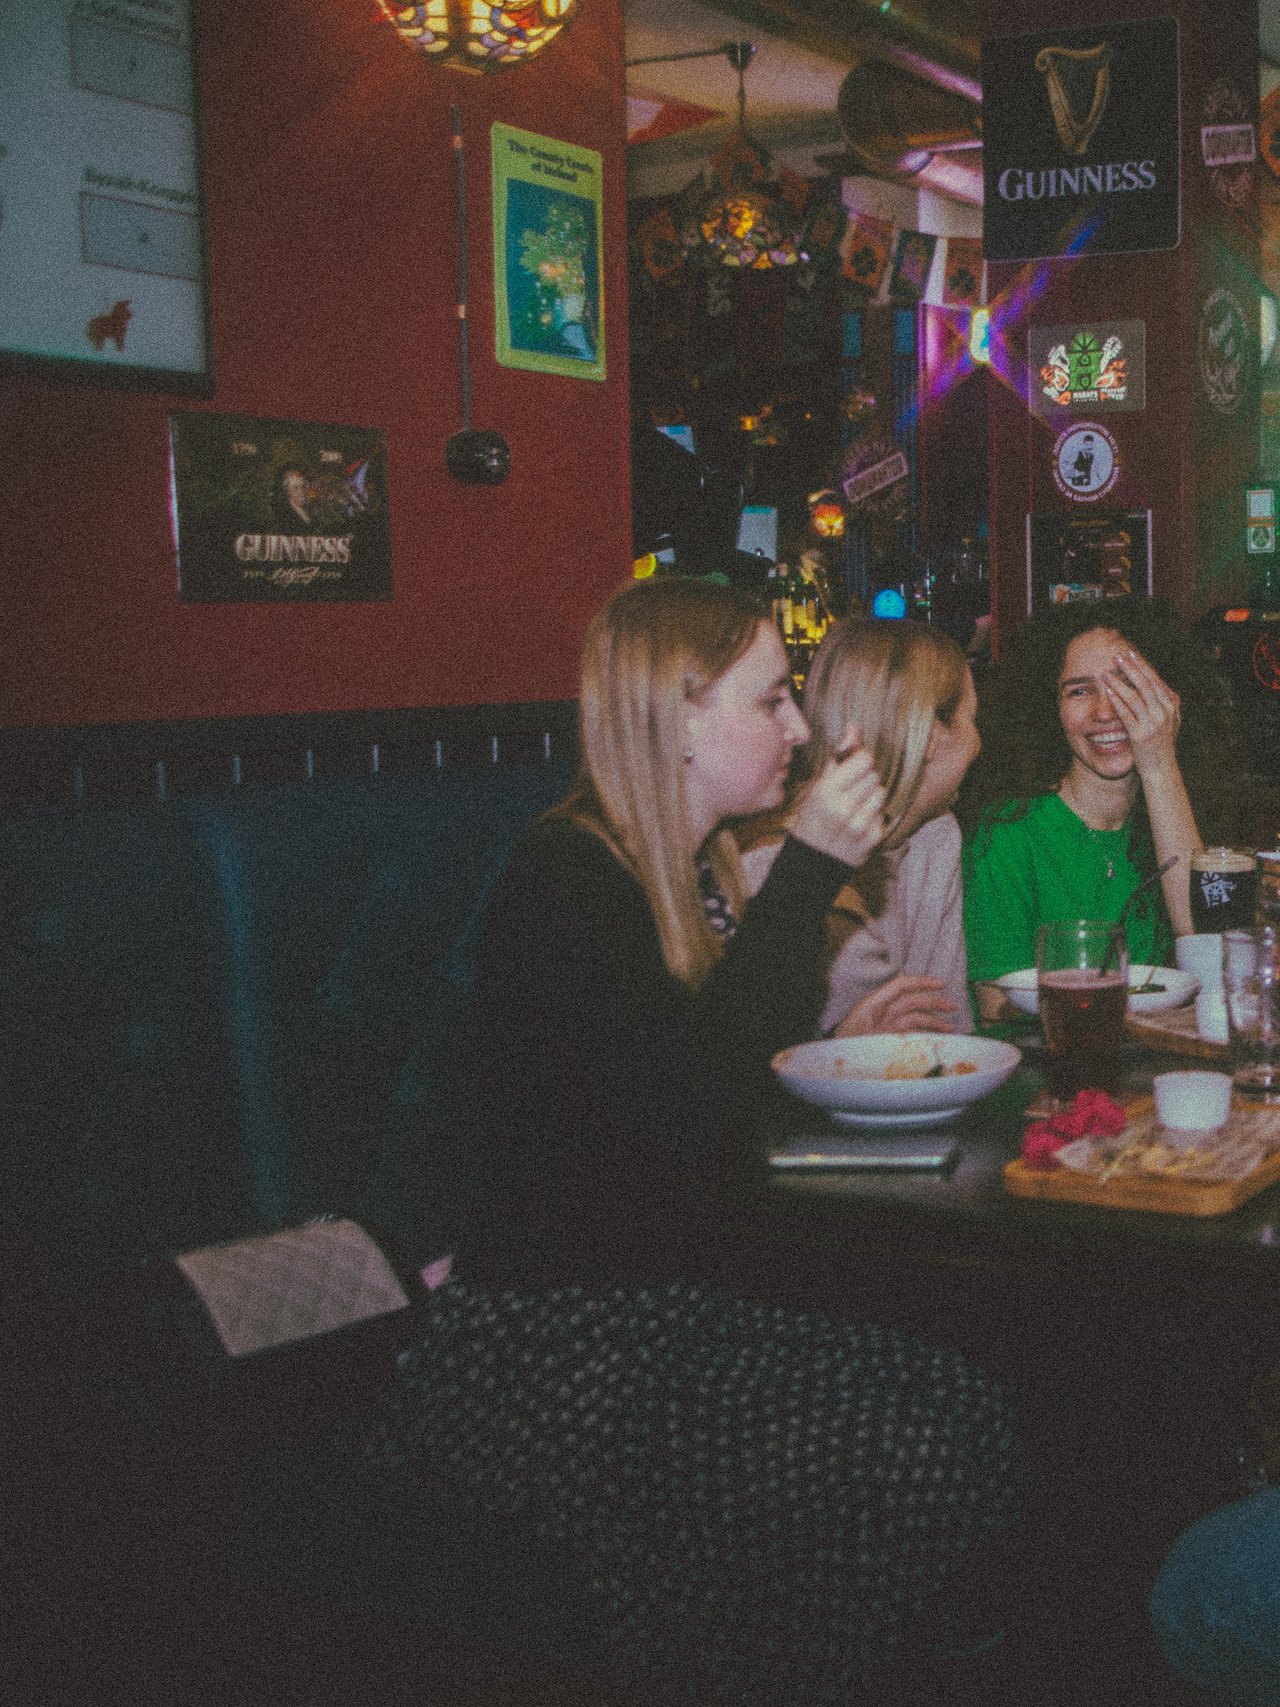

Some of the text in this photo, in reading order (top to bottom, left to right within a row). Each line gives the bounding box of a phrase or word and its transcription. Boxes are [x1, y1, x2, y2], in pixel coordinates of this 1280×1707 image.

[507, 139, 527, 155] The
[529, 161, 577, 183] of Ireland
[997, 159, 1157, 203] GUINNESS
[234, 533, 352, 564] GUINNESS
